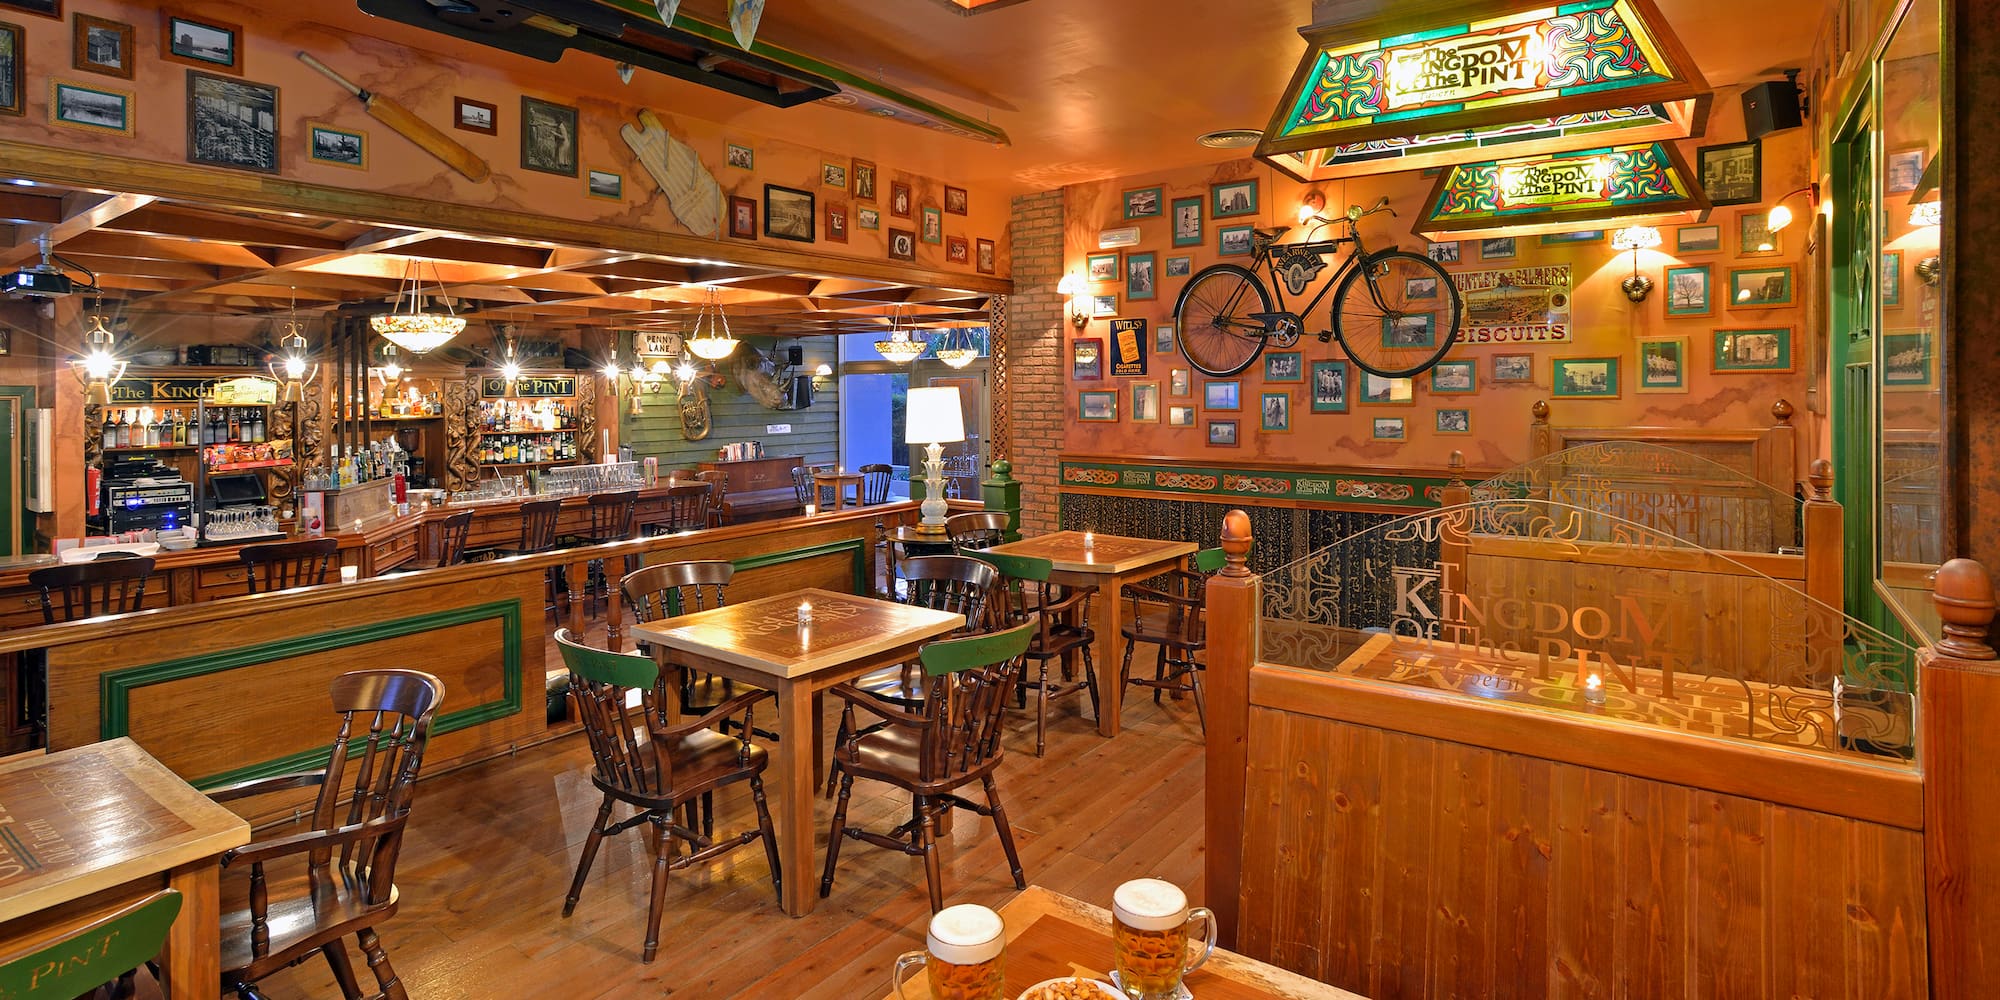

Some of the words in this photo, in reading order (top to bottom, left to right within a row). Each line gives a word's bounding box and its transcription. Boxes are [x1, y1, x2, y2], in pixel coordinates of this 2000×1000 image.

[1400, 35, 1531, 74] INGDOM
[1423, 47, 1458, 63] The
[1420, 70, 1458, 88] The
[1462, 58, 1530, 88] PINT
[1512, 165, 1596, 186] INGDOM
[1523, 166, 1548, 178] The
[1525, 183, 1550, 194] The
[1552, 179, 1598, 195] PINT
[1516, 266, 1569, 287] PALMERS
[646, 335, 673, 345] PENNY
[1453, 325, 1565, 343] BISCUITS
[648, 344, 670, 353] LANE
[112, 386, 145, 399] The
[532, 380, 569, 394] PINT
[1391, 573, 1676, 649] KINGDOM
[1390, 617, 1439, 650] Of
[1443, 623, 1521, 662] The
[1532, 635, 1681, 700] PINT
[28, 930, 120, 993] PINT
